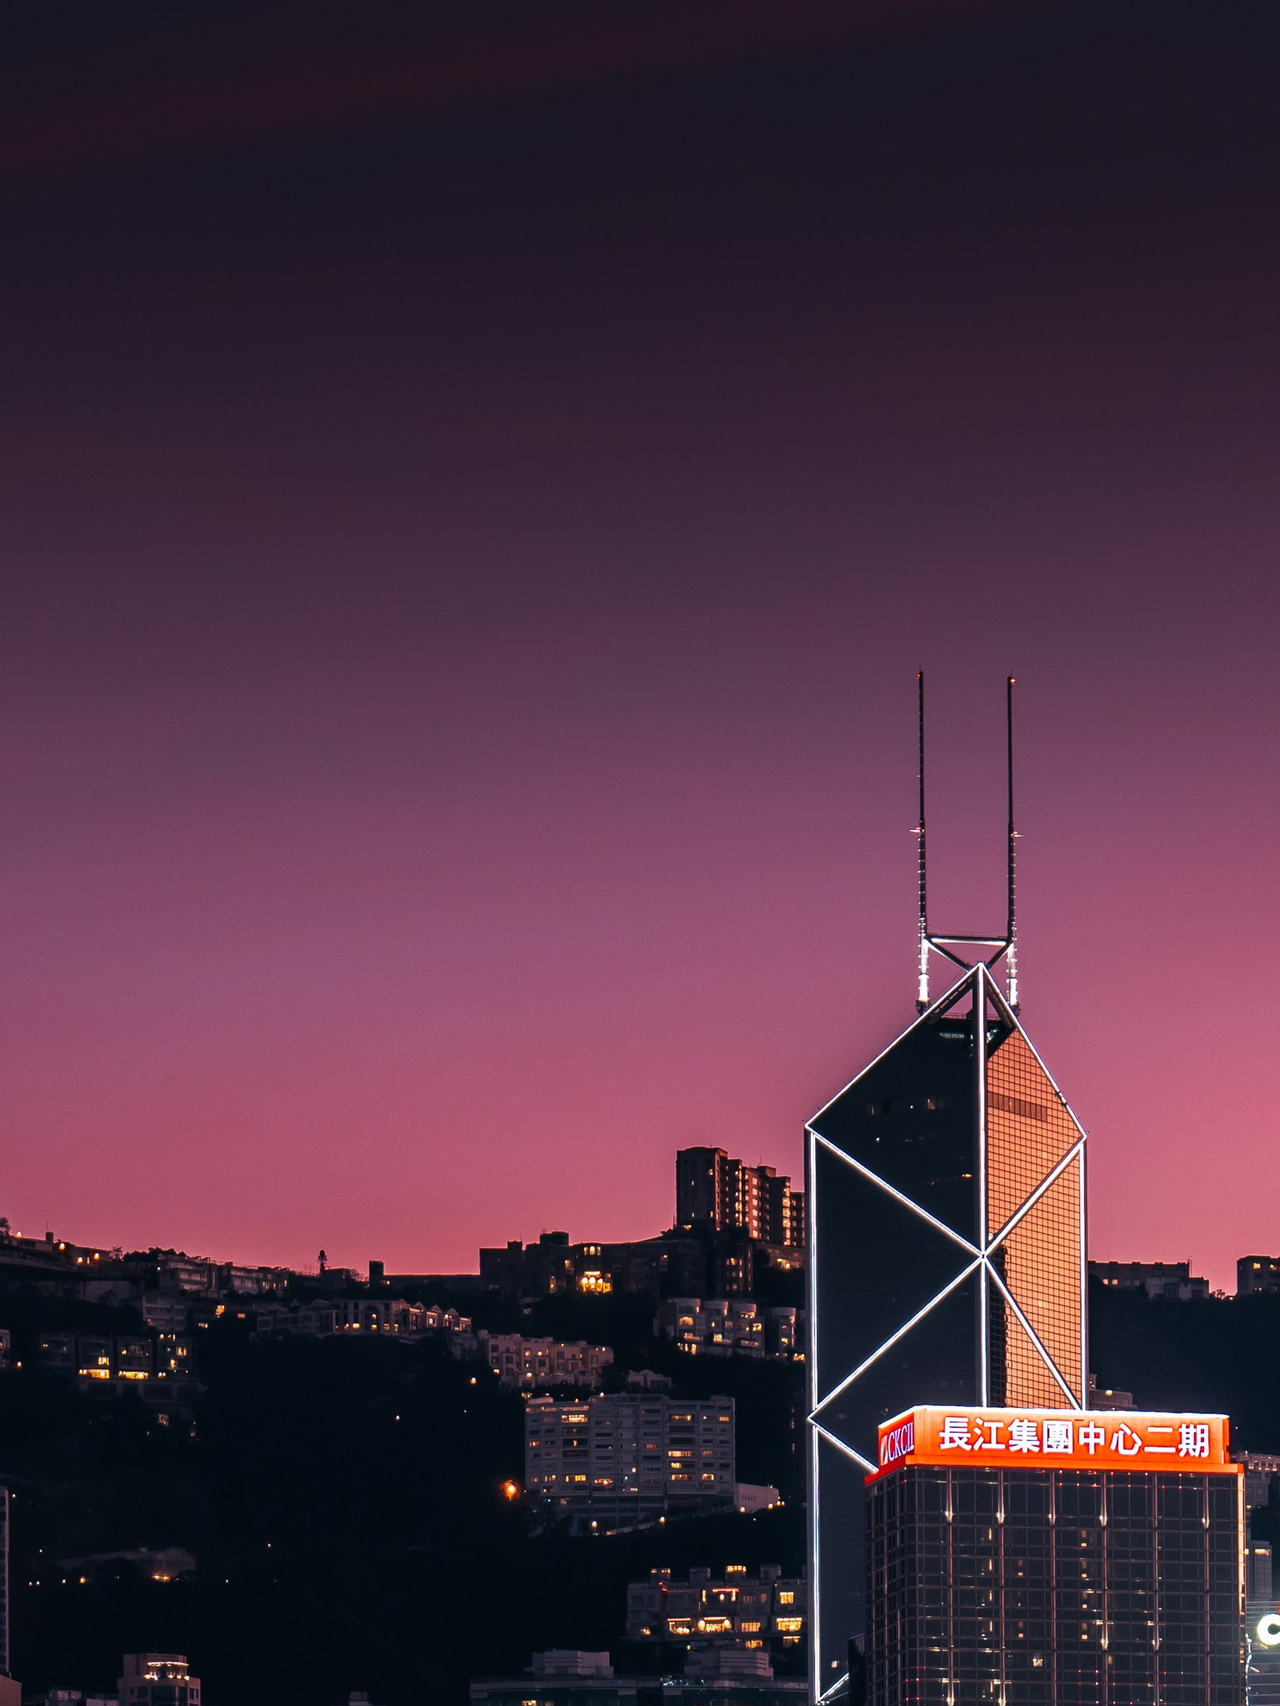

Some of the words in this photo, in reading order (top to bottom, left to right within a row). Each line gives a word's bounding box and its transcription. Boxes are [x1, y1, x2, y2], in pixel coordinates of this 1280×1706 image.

[938, 1416, 1210, 1458] 長江集團中心二期
